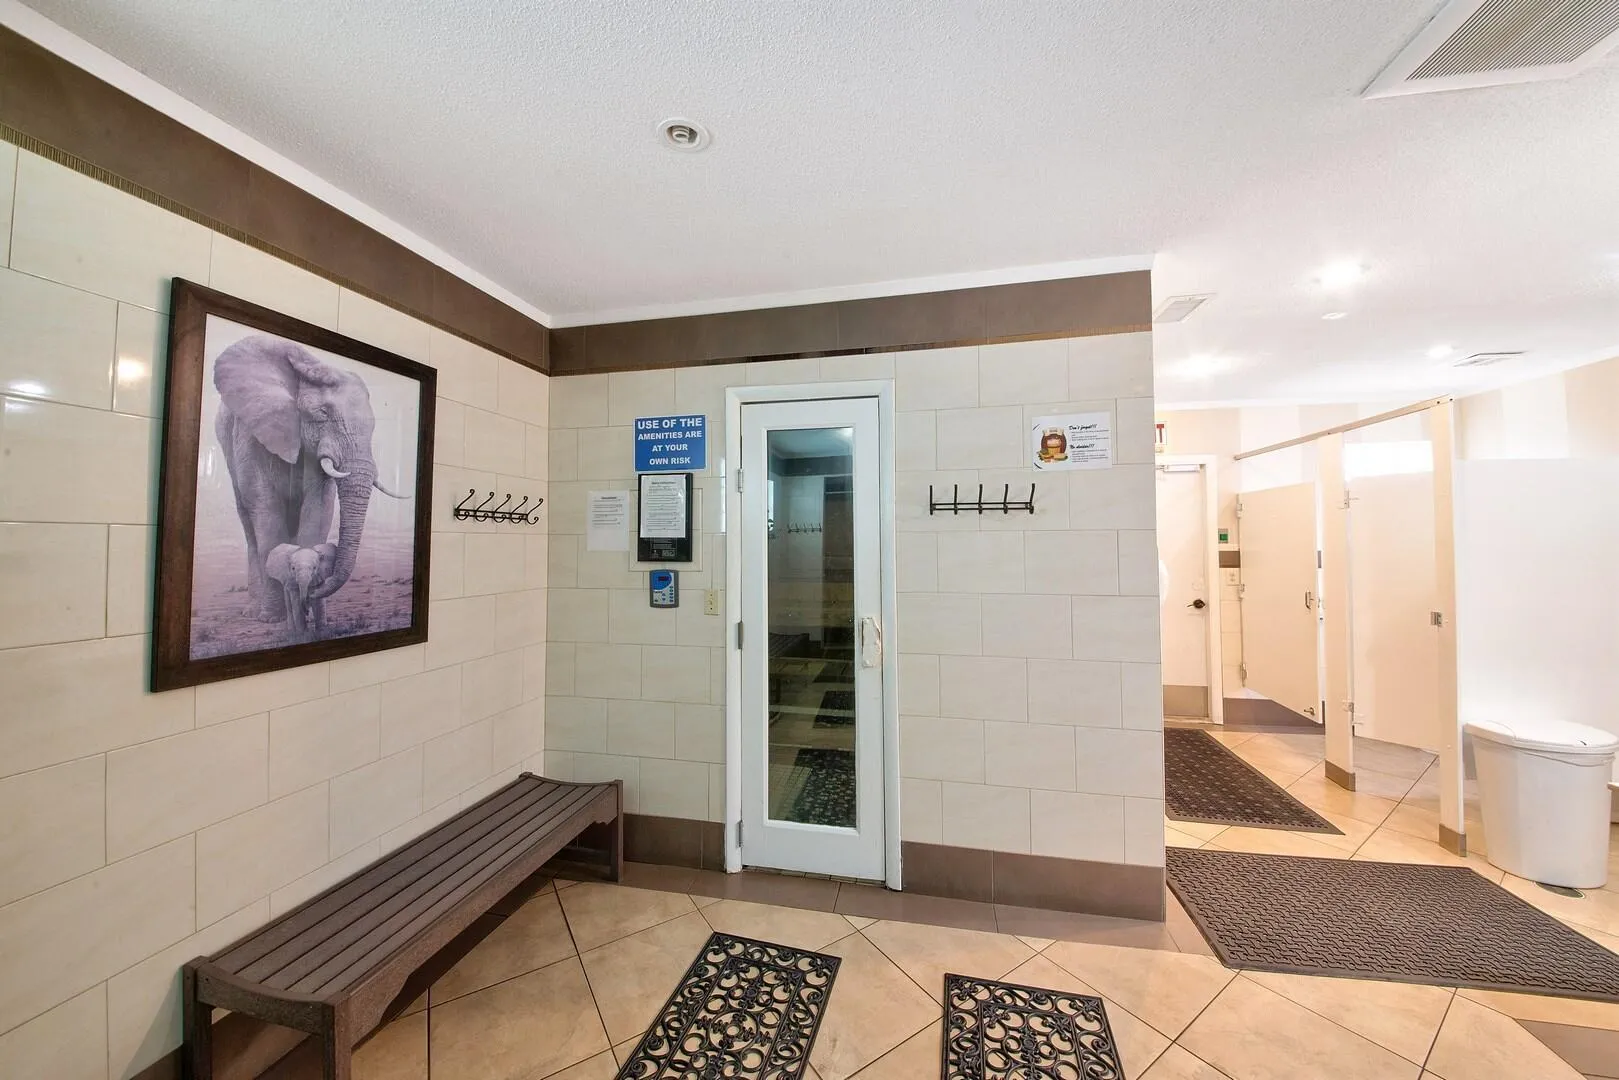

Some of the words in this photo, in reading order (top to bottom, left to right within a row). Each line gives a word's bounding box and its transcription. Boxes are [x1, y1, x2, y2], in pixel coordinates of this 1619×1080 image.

[637, 420, 660, 430] USE
[662, 419, 677, 429] OF
[680, 417, 703, 428] THE
[637, 431, 683, 441] AMENITIES
[684, 430, 702, 439] ARE
[652, 444, 664, 452] AT
[665, 443, 688, 452] YOUR
[649, 457, 669, 466] OWN
[670, 456, 691, 465] RISK
